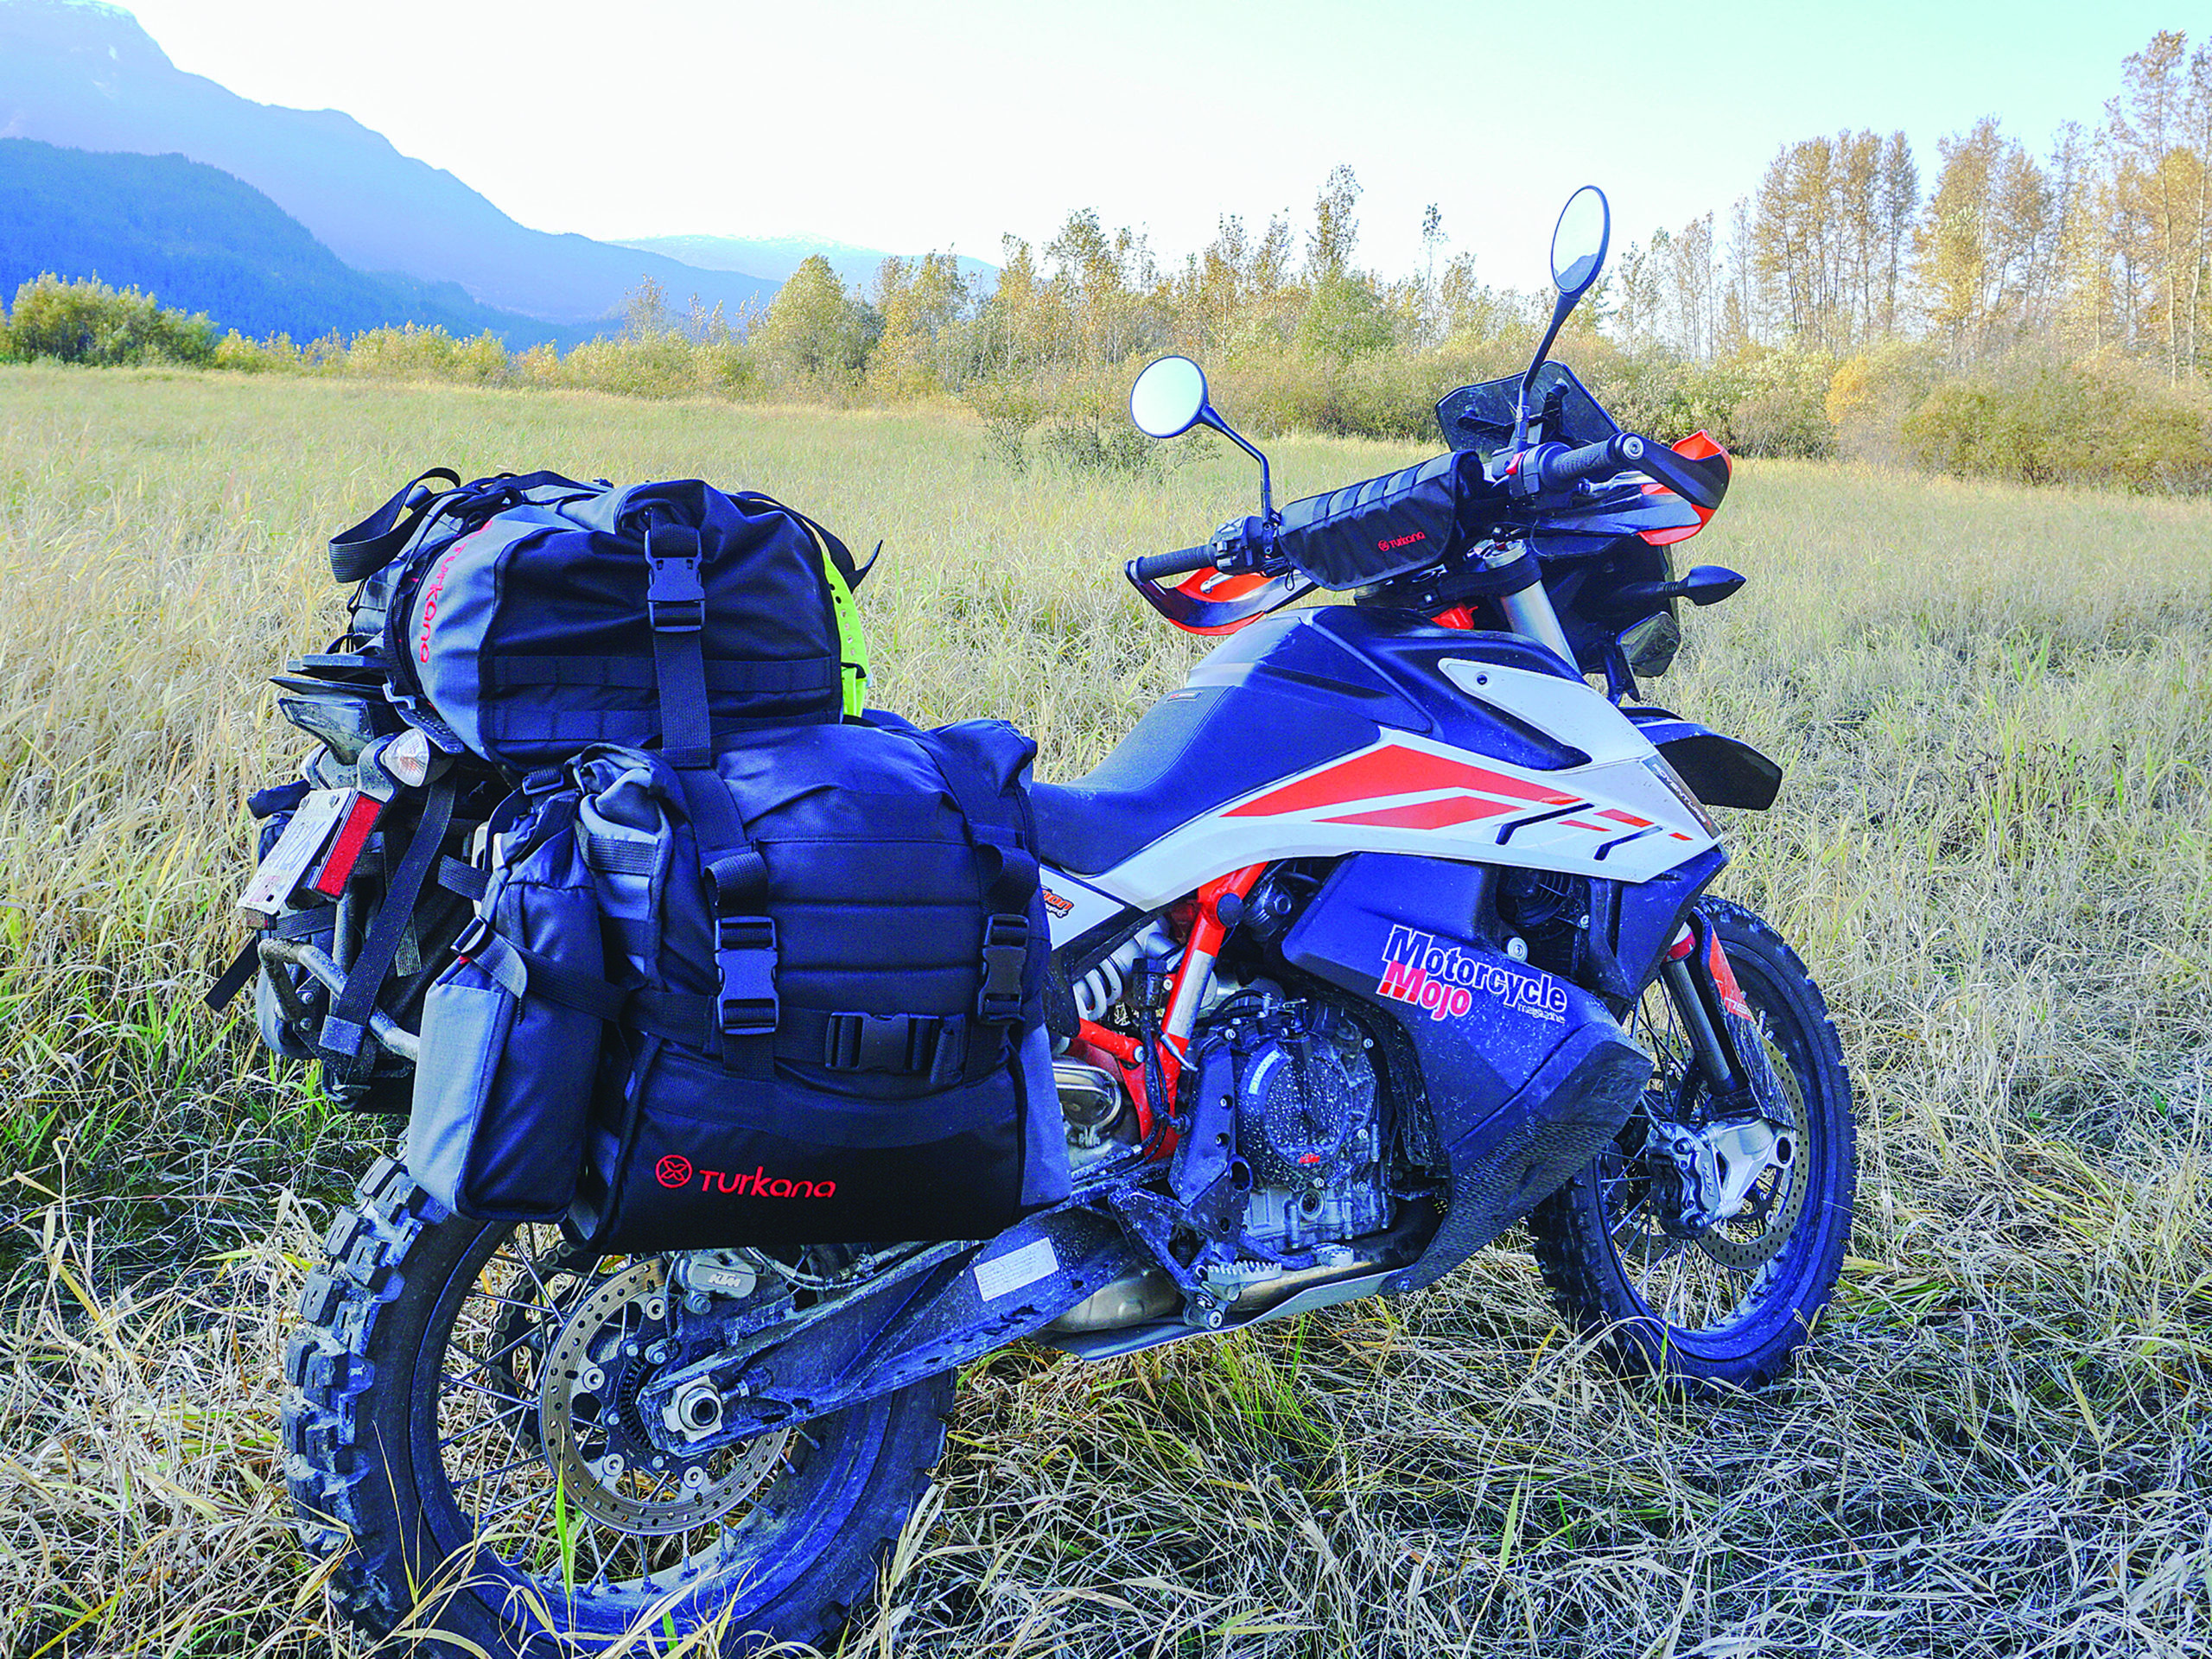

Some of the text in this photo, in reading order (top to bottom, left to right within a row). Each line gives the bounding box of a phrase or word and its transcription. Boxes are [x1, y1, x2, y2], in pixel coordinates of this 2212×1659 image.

[419, 542, 467, 664] Turkana
[1376, 959, 1472, 1021] Mojo
[1382, 924, 1567, 1013] Motorcycle
[698, 1166, 837, 1198] Turkana
[707, 1271, 741, 1288] KTM
